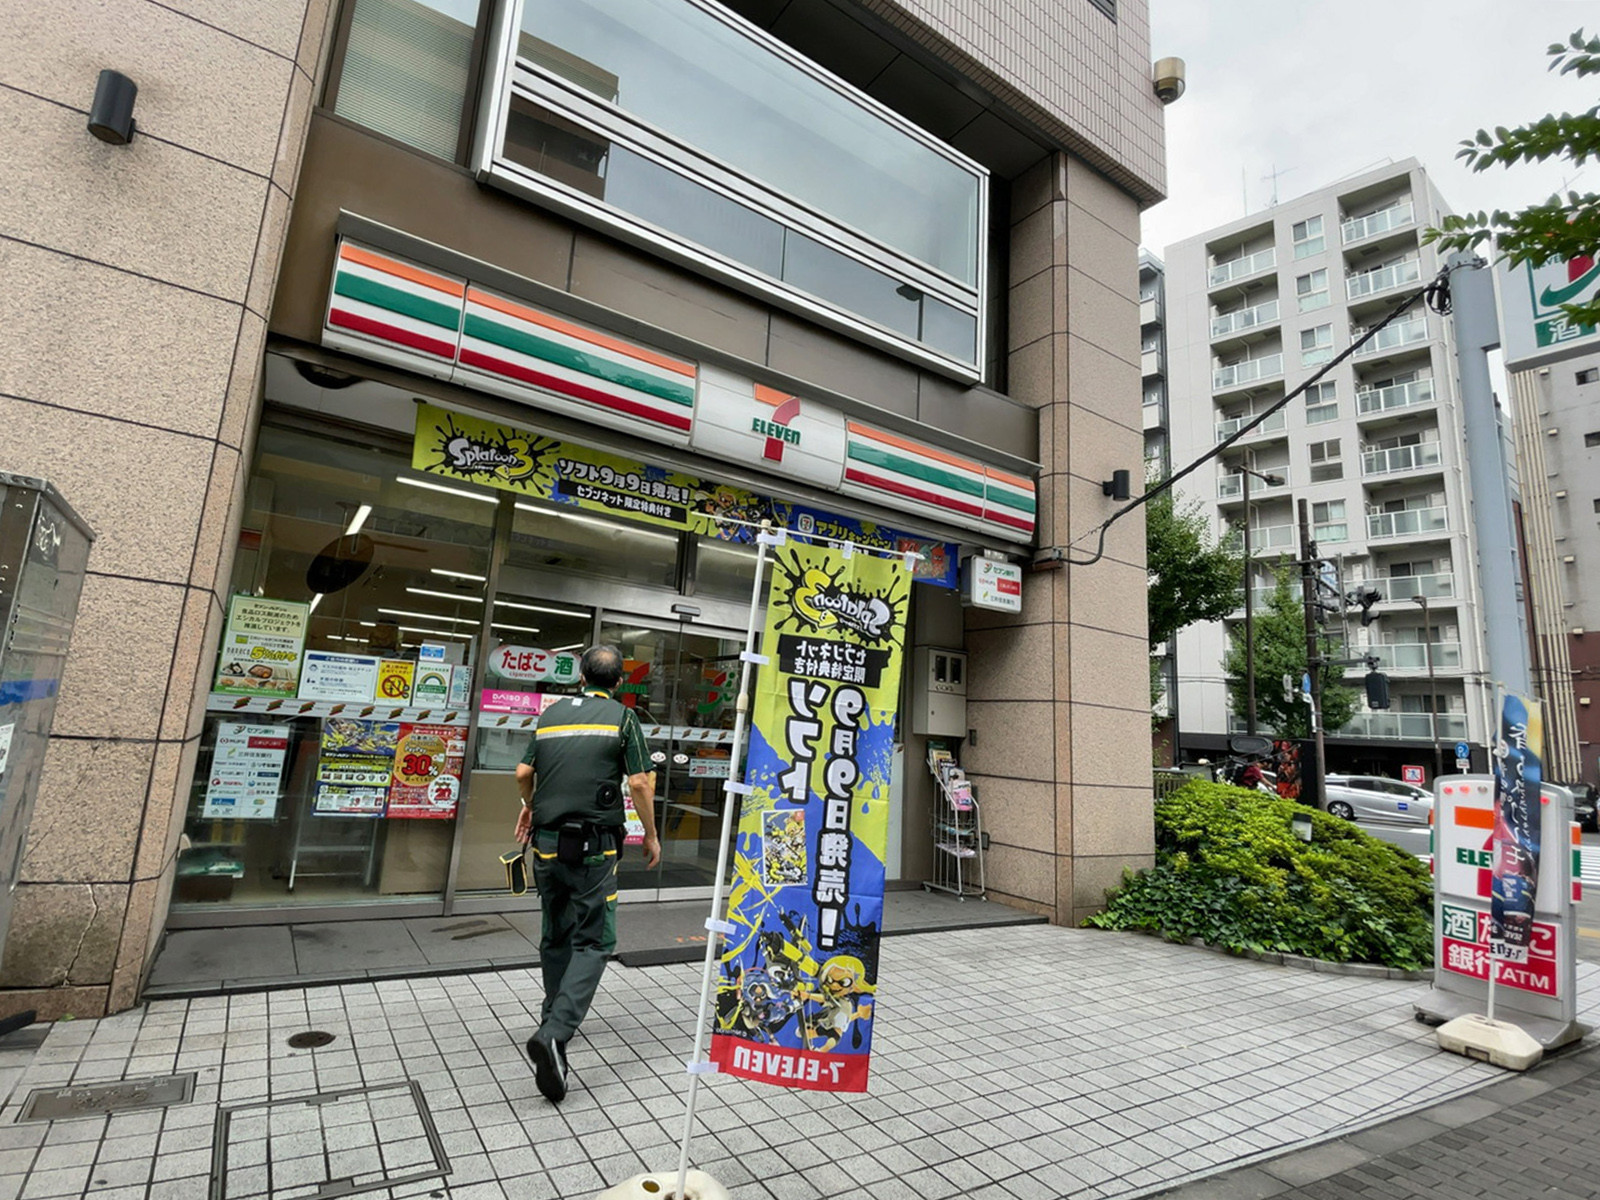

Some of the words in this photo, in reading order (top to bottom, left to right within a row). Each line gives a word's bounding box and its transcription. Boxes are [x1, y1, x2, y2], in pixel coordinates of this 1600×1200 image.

[448, 438, 518, 466] Splatoon
[501, 650, 546, 673] たばこ
[554, 655, 574, 676] 酒
[492, 693, 521, 702] DAISO
[1444, 906, 1475, 939] 酒
